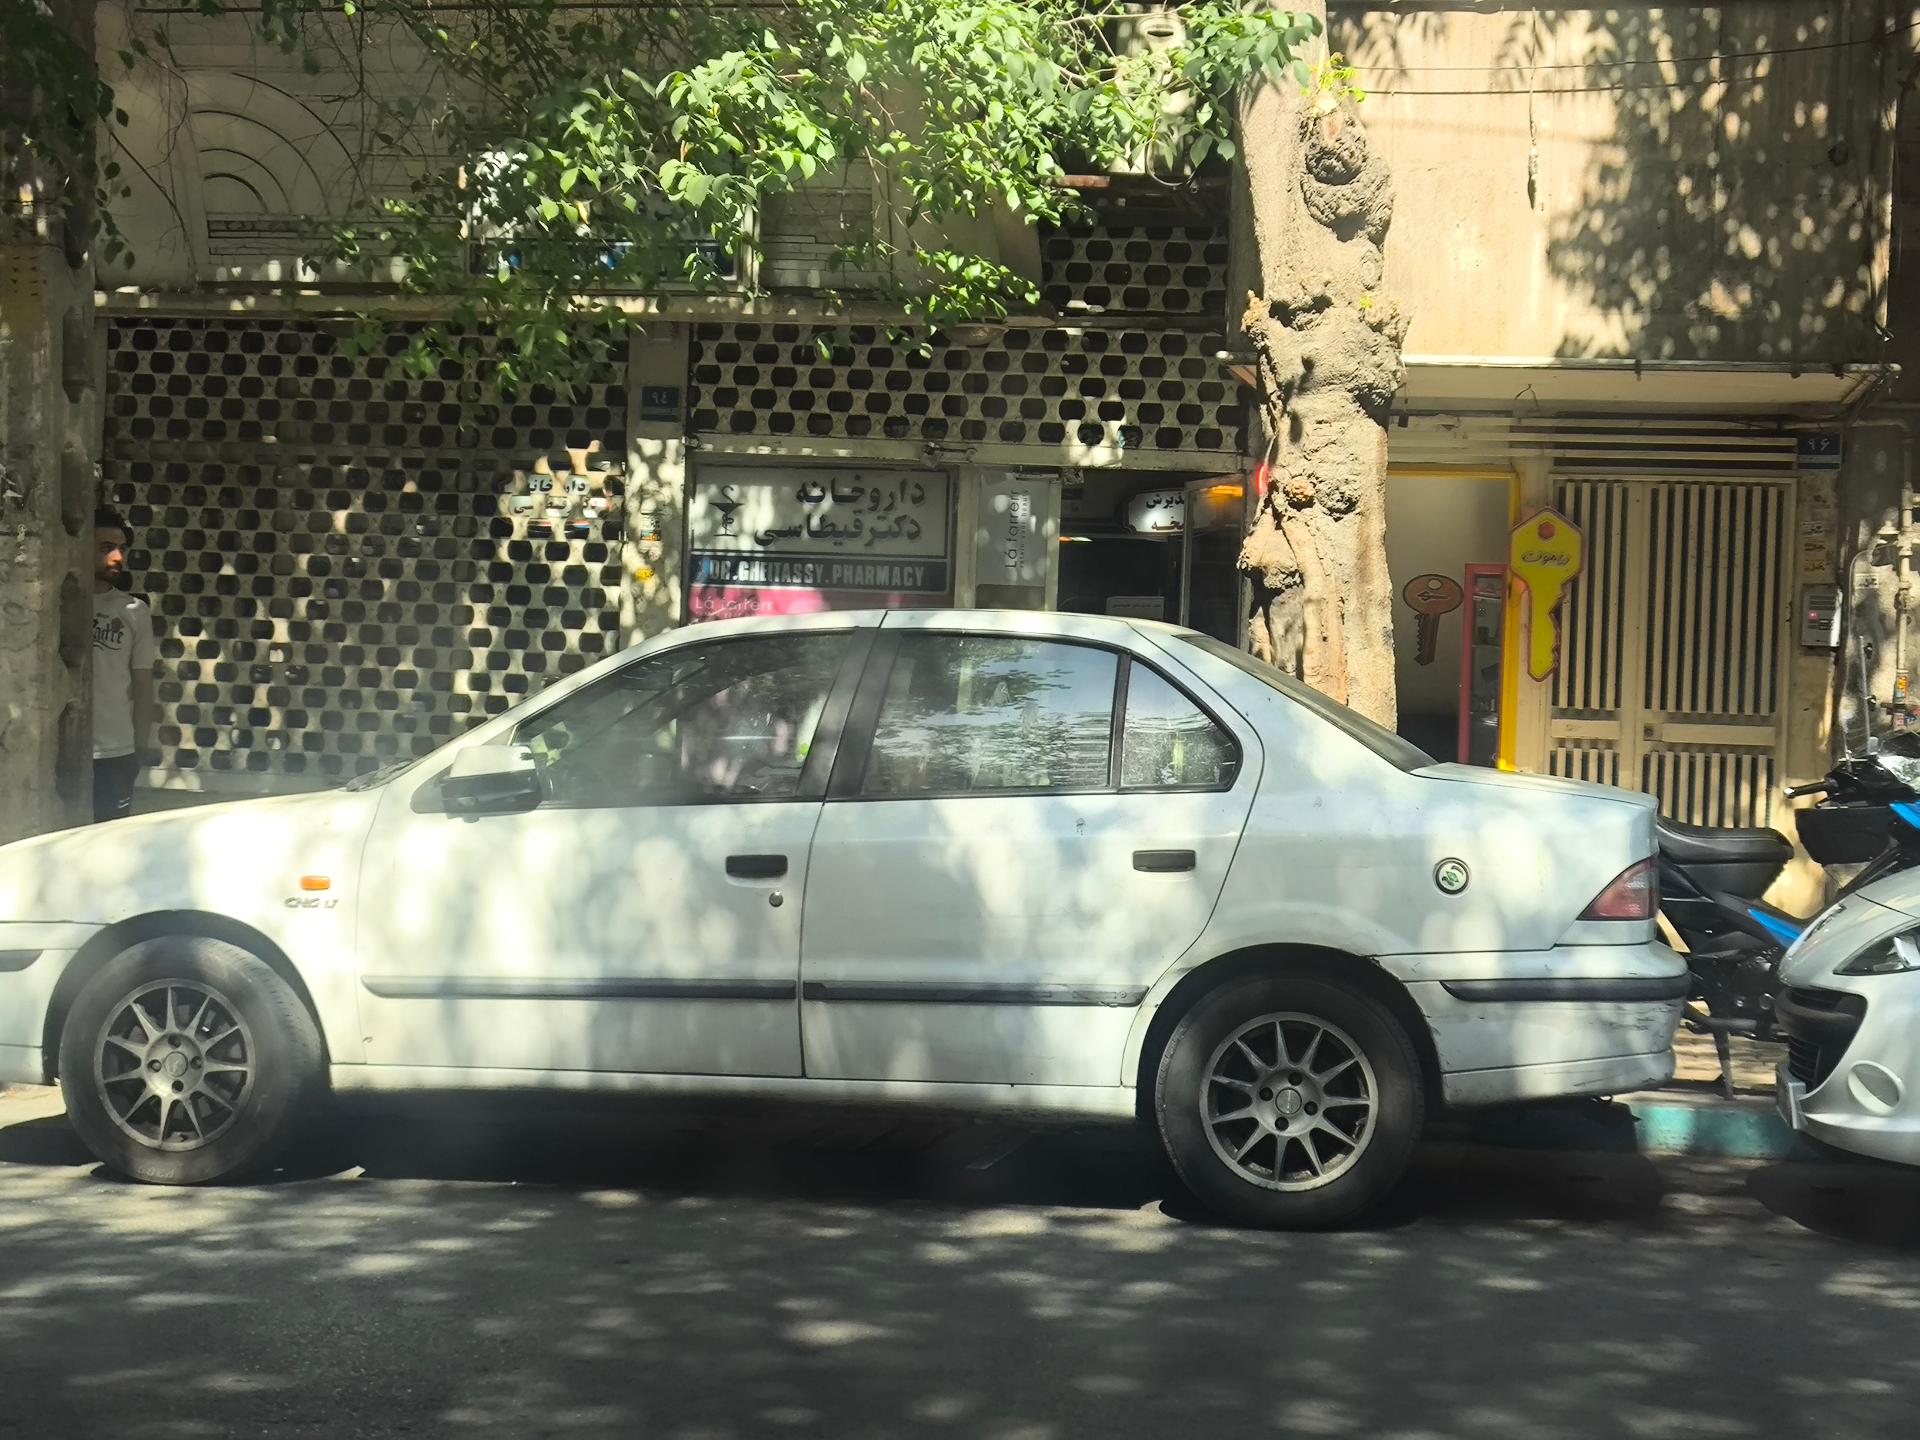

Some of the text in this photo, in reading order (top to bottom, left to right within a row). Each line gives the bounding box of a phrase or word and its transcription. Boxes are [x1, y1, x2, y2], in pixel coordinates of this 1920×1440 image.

[796, 474, 925, 512] داروخانه
[754, 509, 921, 547] دکتر قیطاسی
[832, 563, 925, 587] PHARMACY
